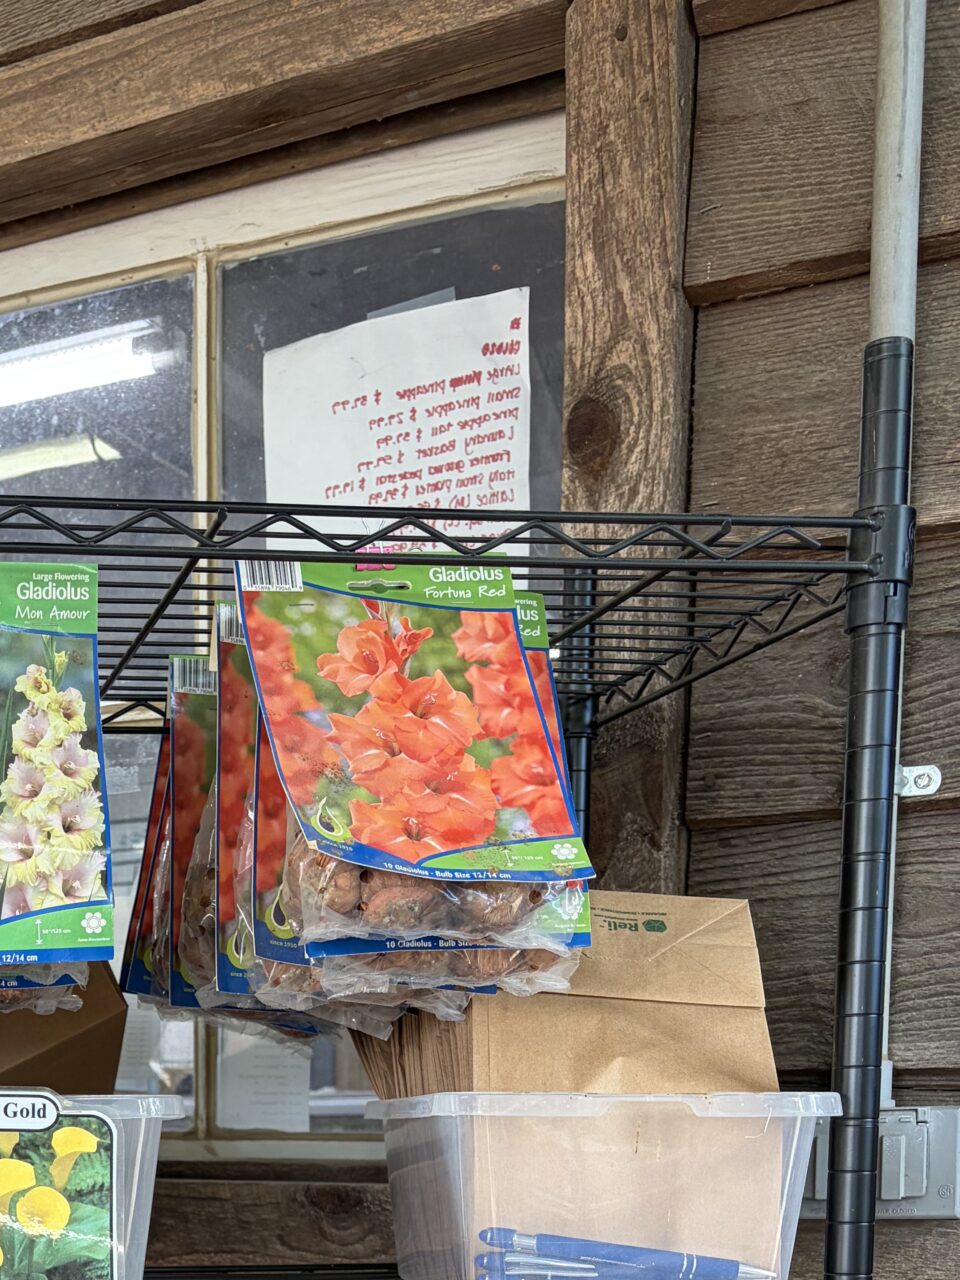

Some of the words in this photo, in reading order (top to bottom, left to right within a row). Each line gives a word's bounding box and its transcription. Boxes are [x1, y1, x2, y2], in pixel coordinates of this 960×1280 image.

[33, 572, 53, 582] Large
[54, 572, 90, 583] Flowering
[428, 566, 504, 582] Gladiolus
[16, 581, 90, 600] Gladiolus
[424, 586, 472, 598] Fortuna
[478, 584, 506, 597] Red
[15, 605, 43, 619] Mon
[49, 605, 91, 620] Amour
[435, 870, 453, 878] Bulb
[454, 871, 471, 879] Size
[472, 871, 497, 879] 12/14
[386, 940, 395, 949] 10
[397, 940, 432, 948] Gladiolus
[439, 939, 456, 947] Bulb
[2, 953, 25, 963] 12/14
[3, 1101, 48, 1119] Gold
